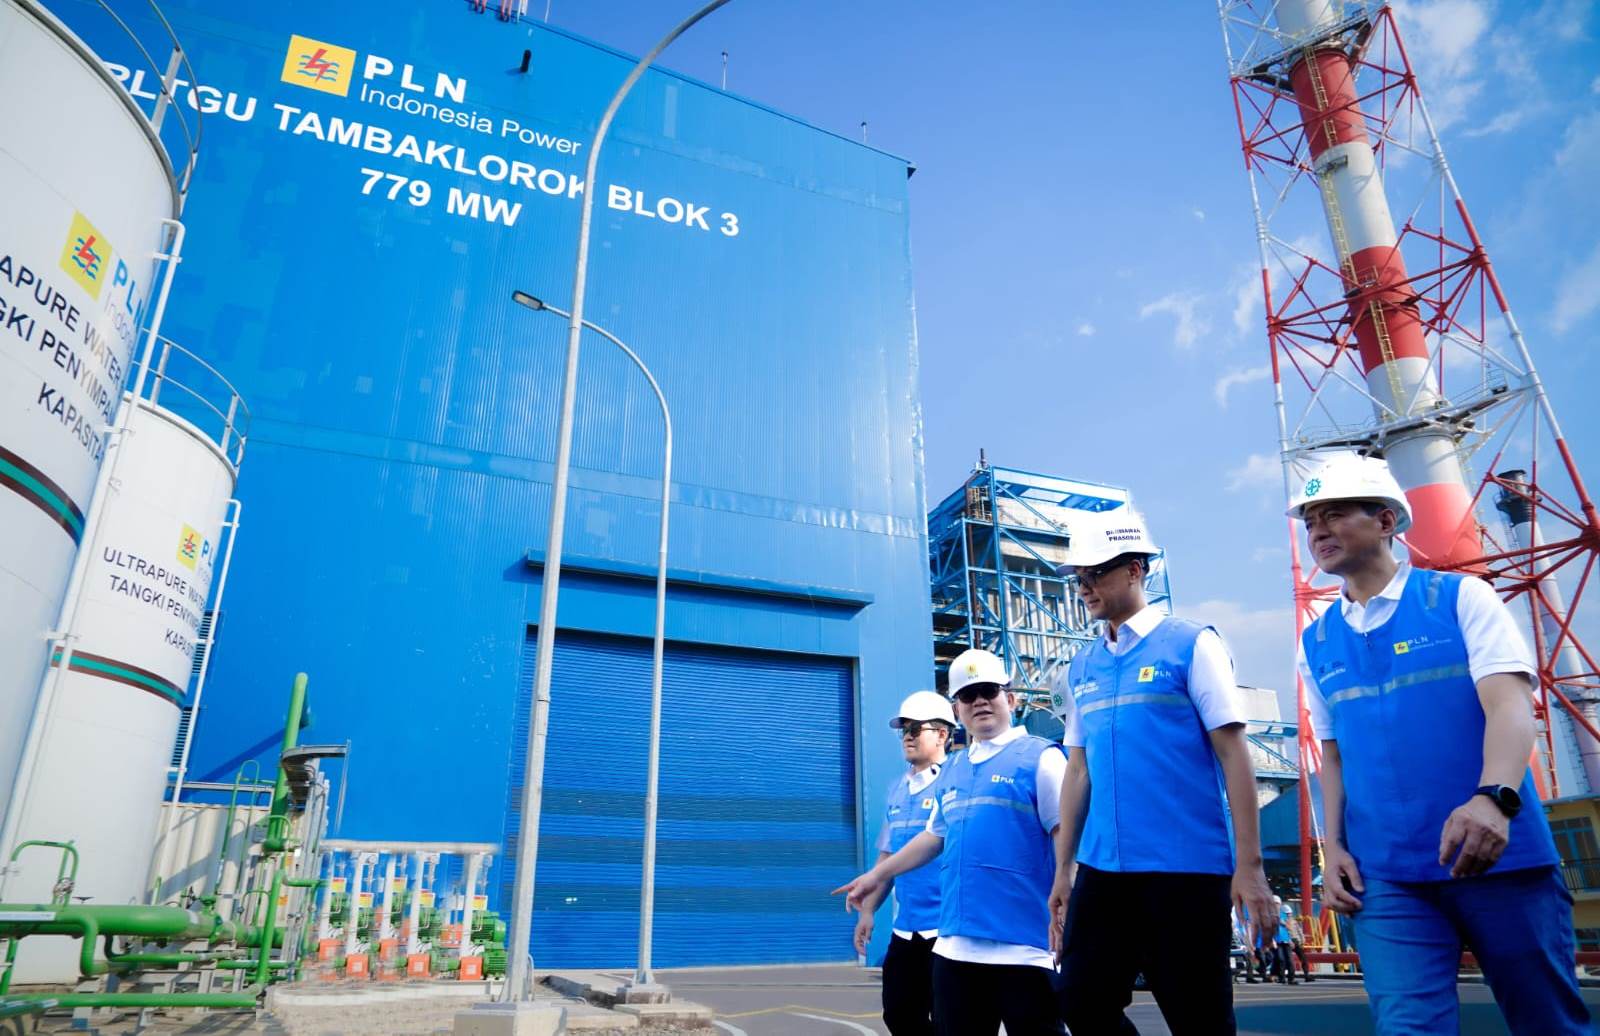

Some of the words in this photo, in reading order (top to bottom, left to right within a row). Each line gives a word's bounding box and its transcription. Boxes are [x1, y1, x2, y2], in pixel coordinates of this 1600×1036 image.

[363, 54, 467, 104] PLN
[360, 83, 493, 134] Indonesia
[501, 119, 582, 155] Power
[273, 103, 585, 198] TAMBAKLOROK
[607, 184, 711, 231] BLOK
[720, 212, 739, 237] 3
[360, 168, 431, 207] 779
[446, 188, 522, 227] MW
[103, 547, 187, 595] ULTRAPURE
[110, 575, 166, 610] TANGKI
[1154, 670, 1172, 680] PLN
